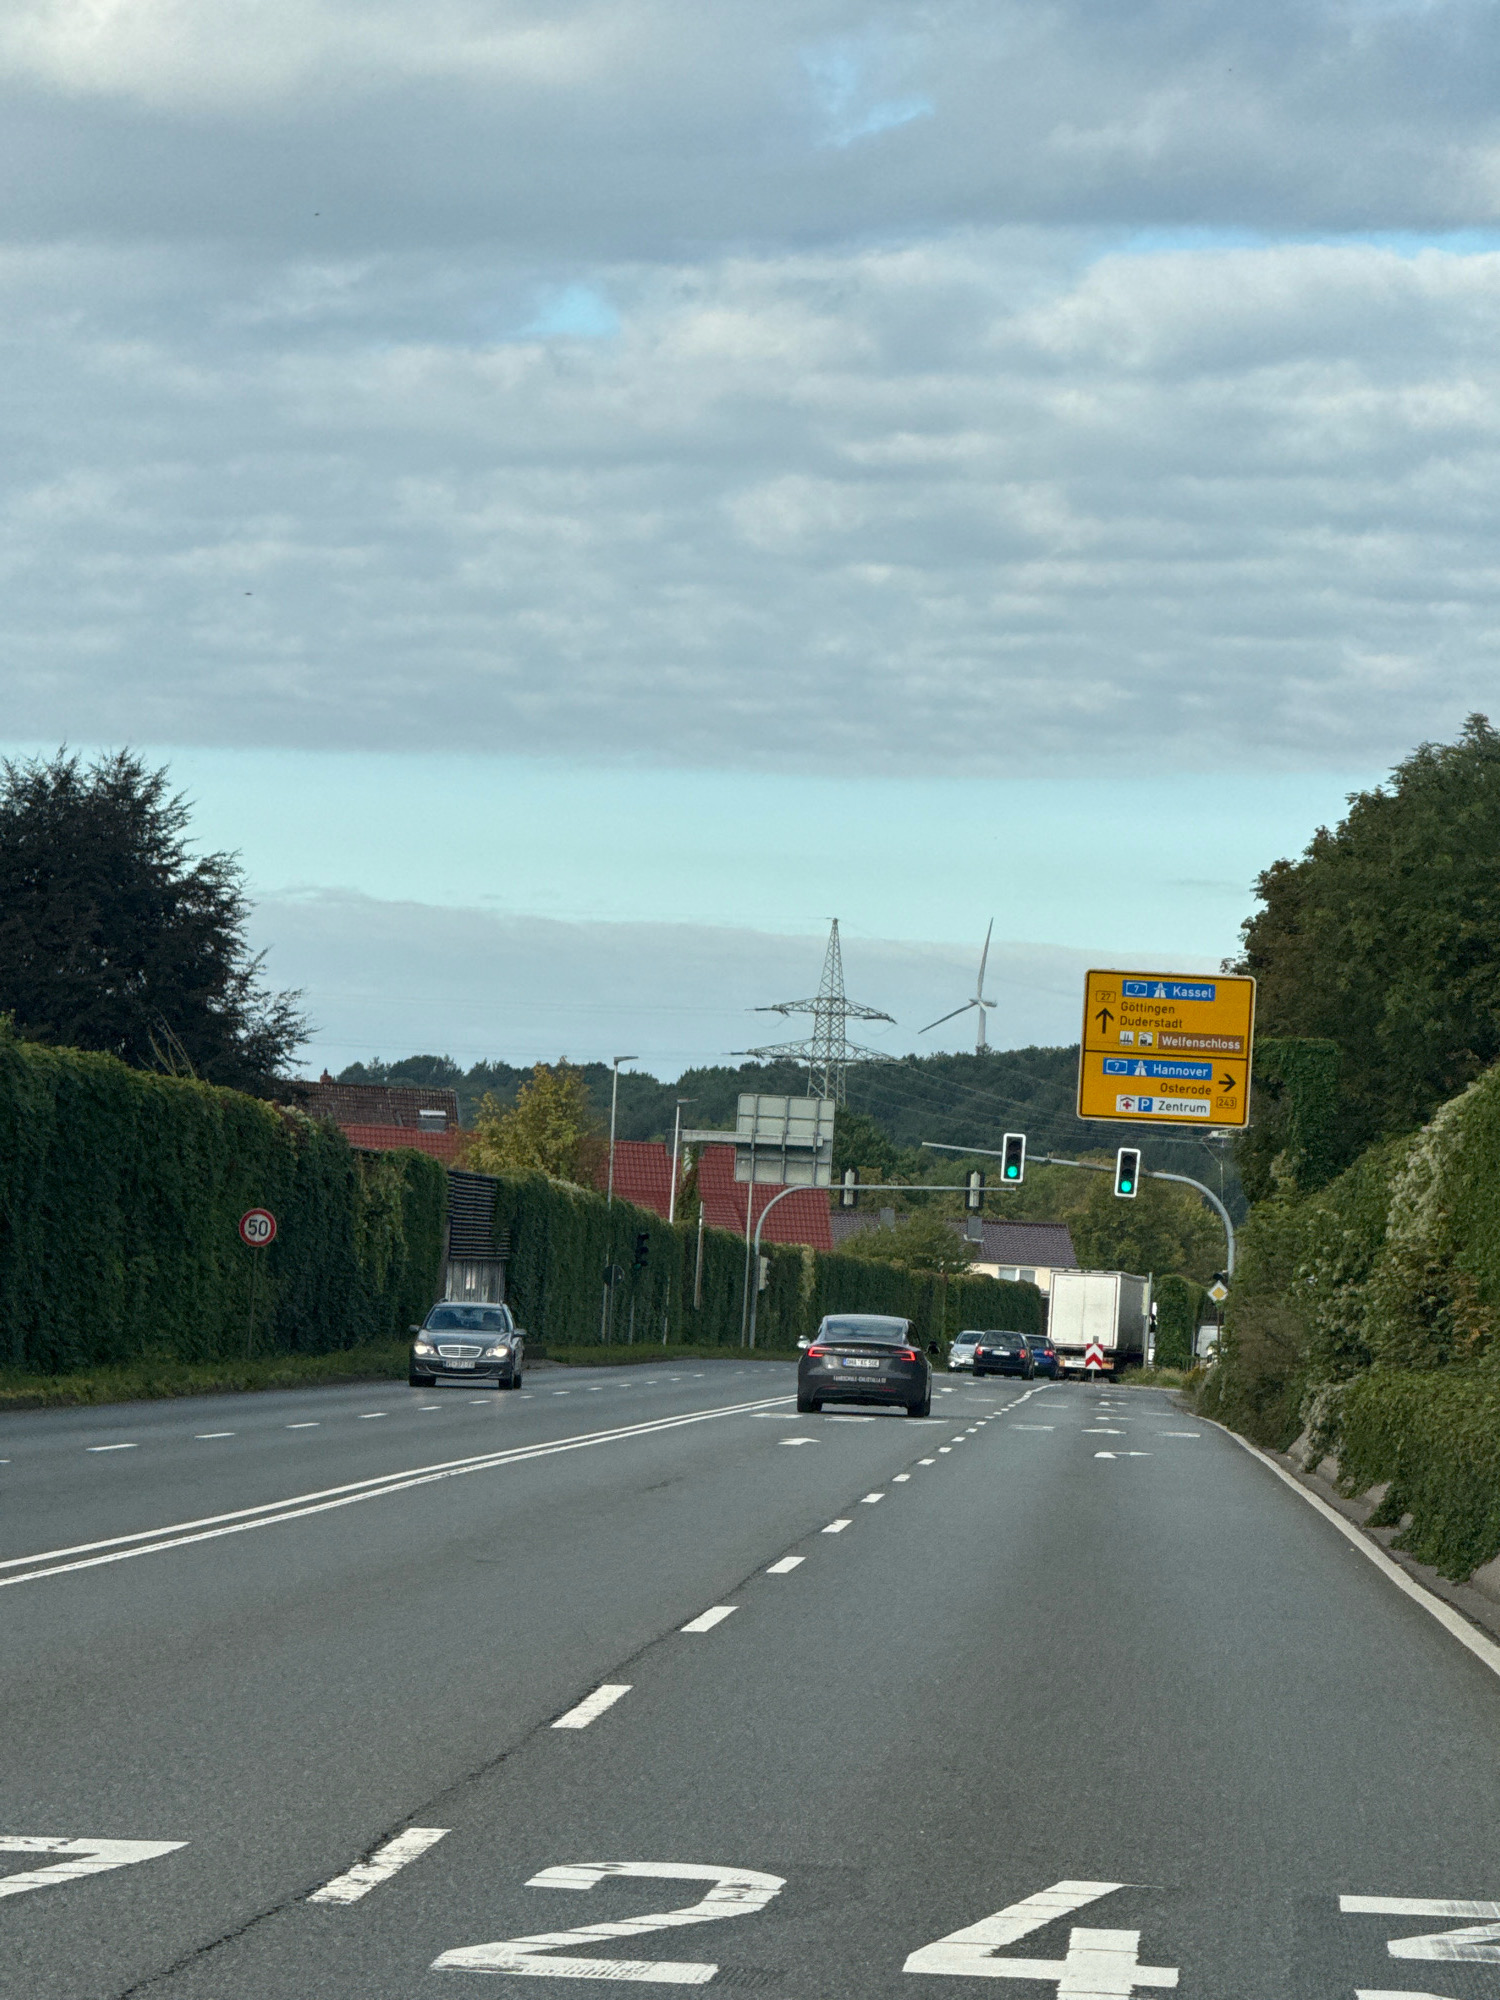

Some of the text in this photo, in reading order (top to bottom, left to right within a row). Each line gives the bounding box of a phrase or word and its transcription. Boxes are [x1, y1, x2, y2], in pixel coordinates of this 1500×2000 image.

[1101, 993, 1111, 1001] 27
[1173, 985, 1212, 998] Kassel
[1121, 1001, 1175, 1016] Göttingen
[1120, 1015, 1182, 1028] Duderstadt
[1162, 1035, 1240, 1049] Welfenschloss
[1153, 1064, 1208, 1077] Hannover
[1160, 1082, 1212, 1095] Osterode
[1141, 1099, 1207, 1113] P Zentrum
[1219, 1099, 1235, 1107] 243
[248, 1219, 268, 1236] 50
